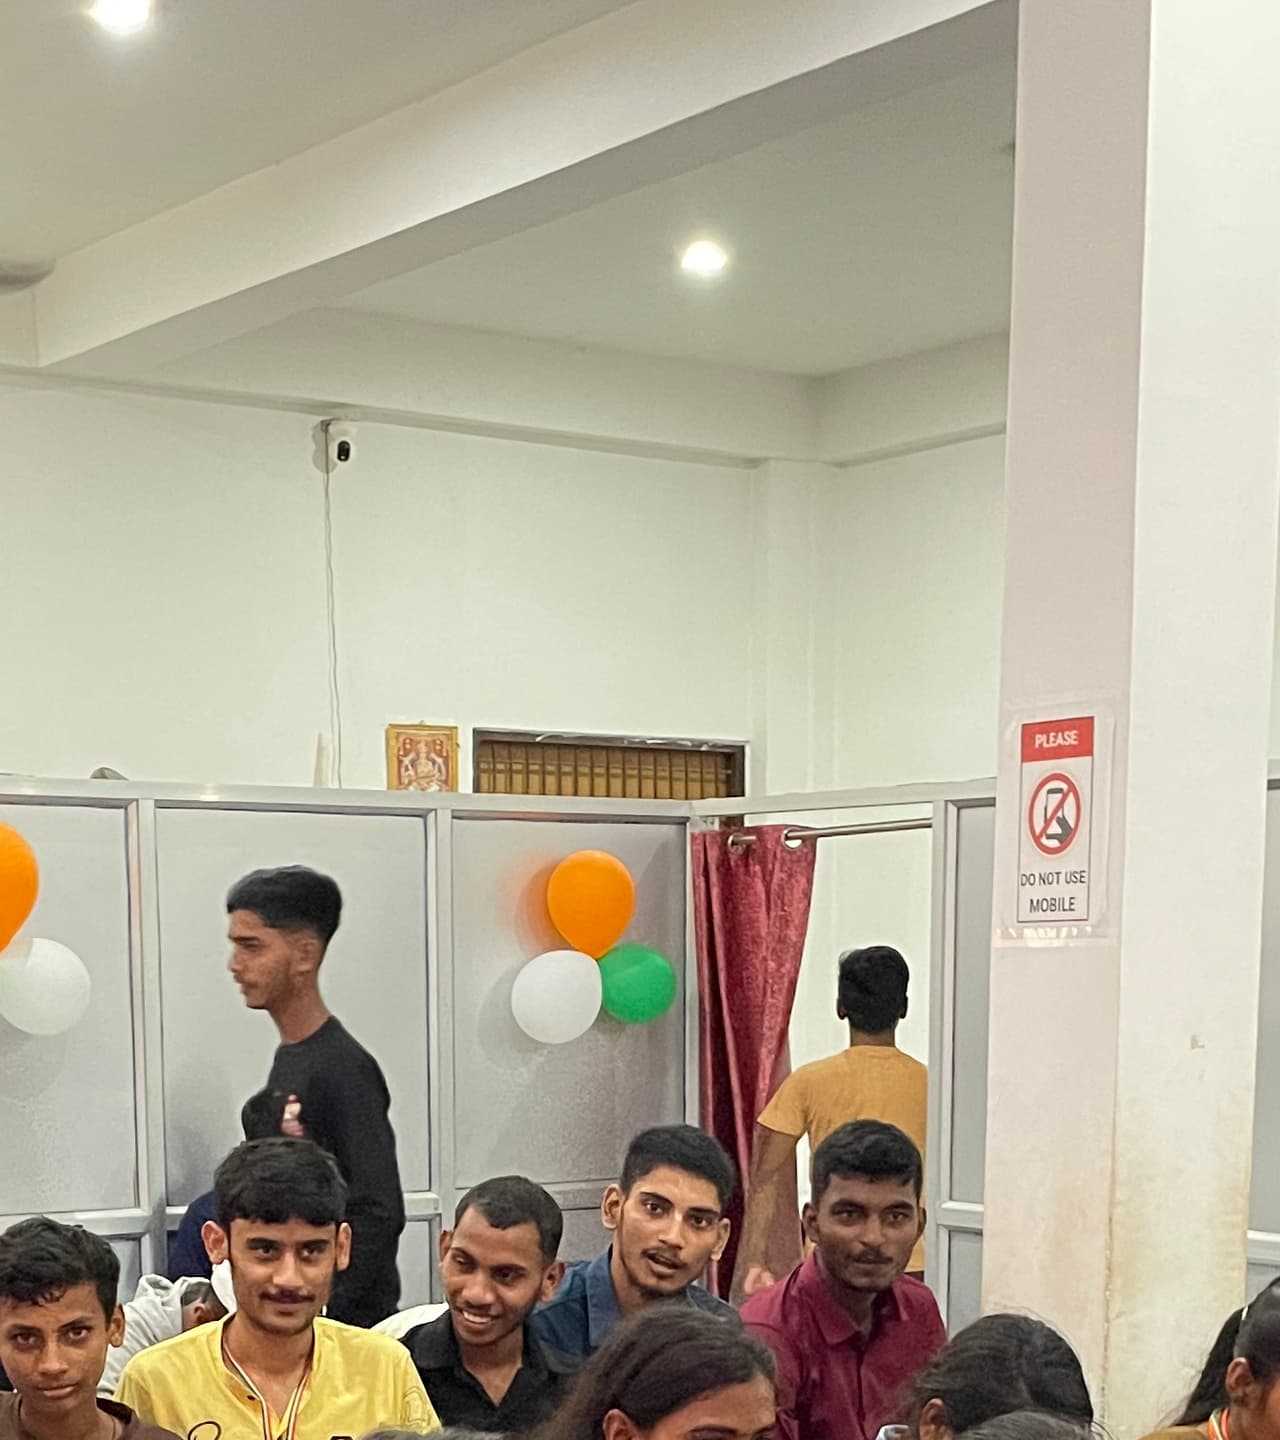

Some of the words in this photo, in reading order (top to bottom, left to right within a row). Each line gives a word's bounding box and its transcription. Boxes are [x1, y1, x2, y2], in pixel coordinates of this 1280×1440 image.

[1035, 730, 1079, 749] PLEASE
[1020, 873, 1036, 887] DO
[1038, 871, 1062, 886] NOT
[1065, 870, 1087, 884] USE
[1029, 896, 1076, 913] MOBILE
